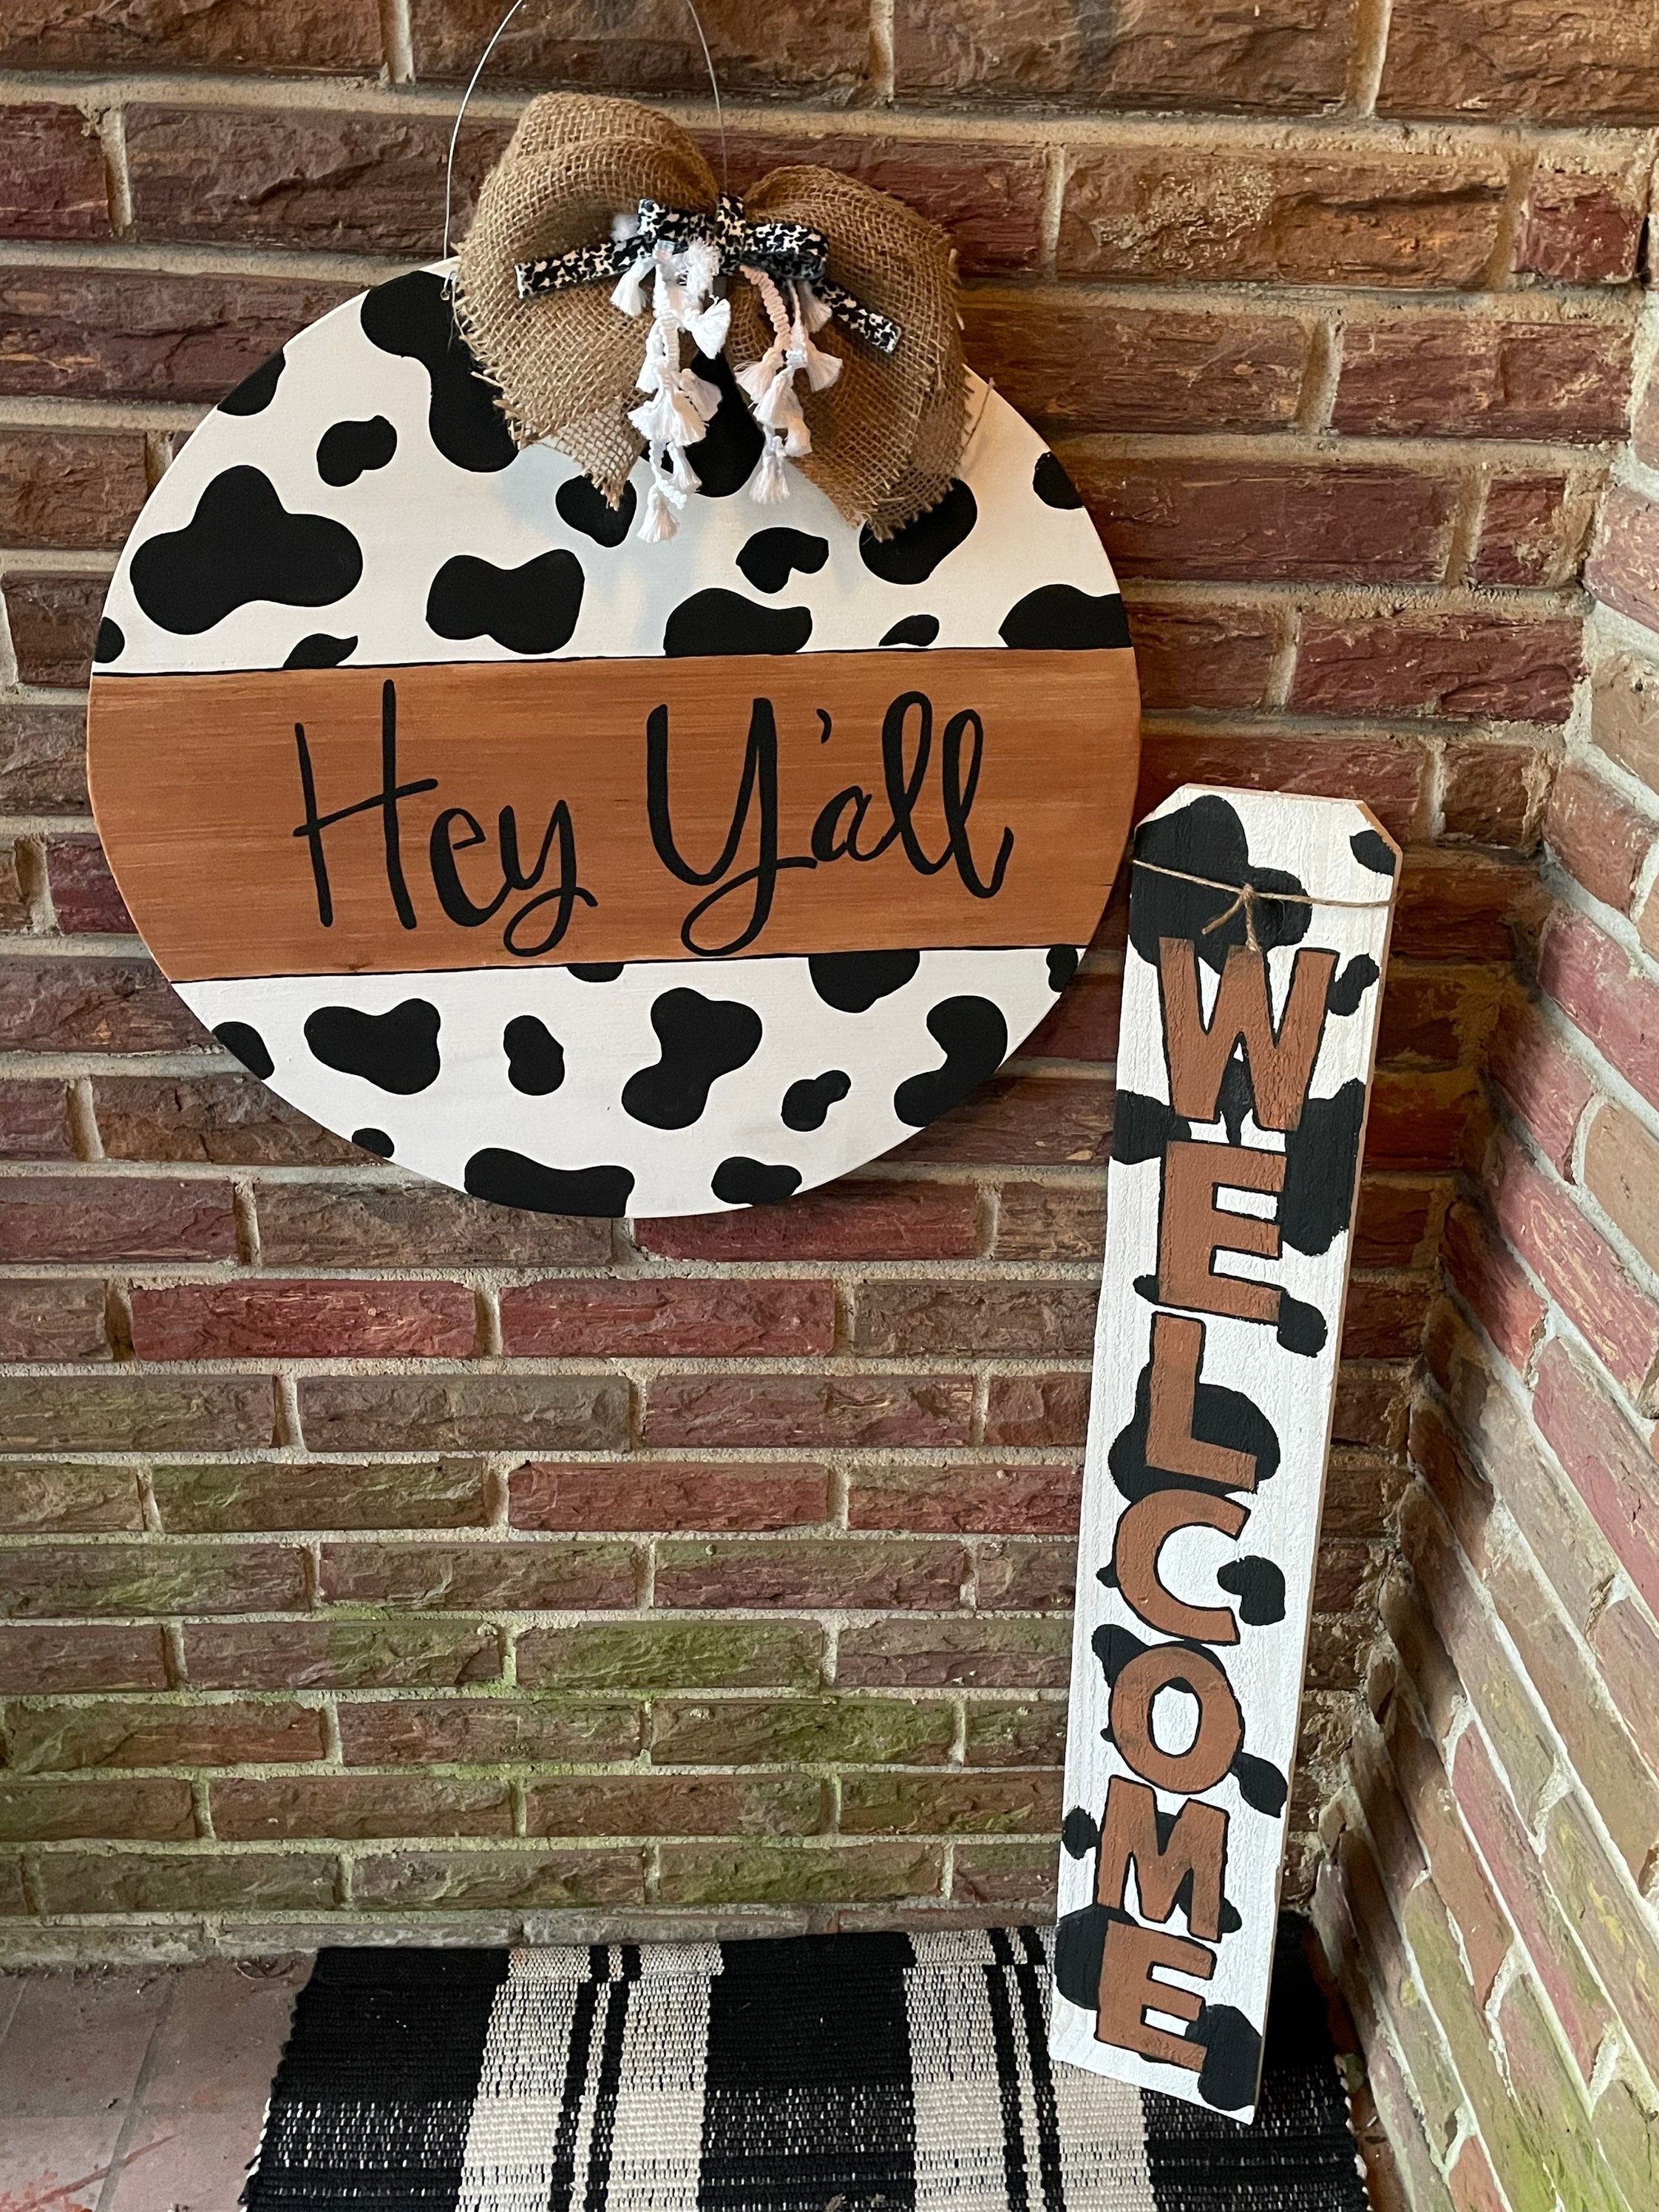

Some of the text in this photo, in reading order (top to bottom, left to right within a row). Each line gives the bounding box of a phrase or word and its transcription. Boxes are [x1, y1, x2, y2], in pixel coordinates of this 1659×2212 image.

[293, 679, 1014, 957] Hey Y'all
[1094, 937, 1338, 2073] WELCOME
